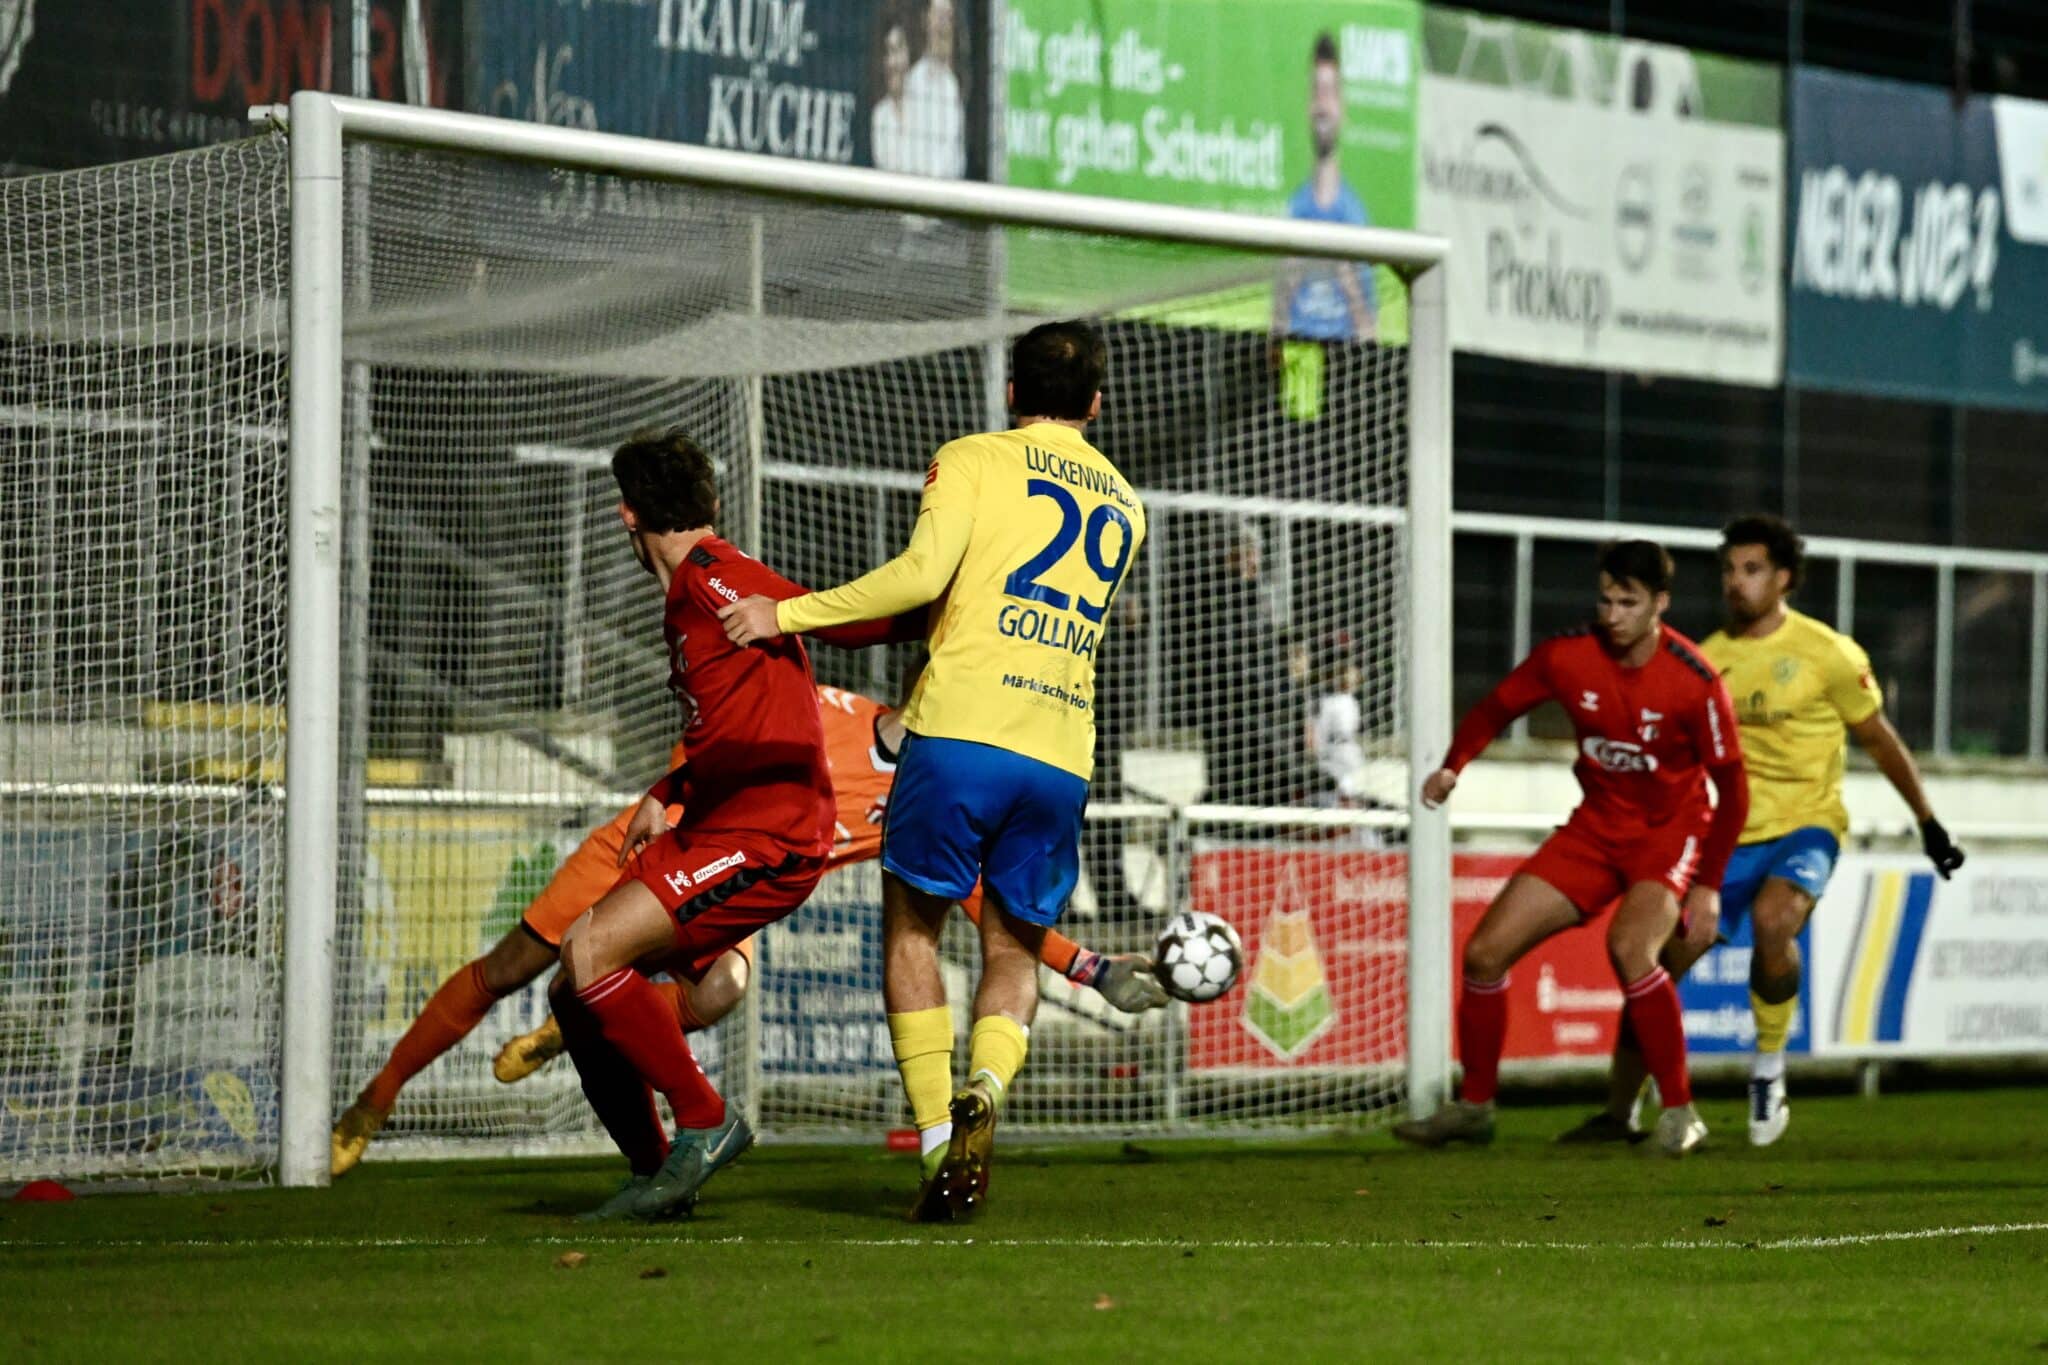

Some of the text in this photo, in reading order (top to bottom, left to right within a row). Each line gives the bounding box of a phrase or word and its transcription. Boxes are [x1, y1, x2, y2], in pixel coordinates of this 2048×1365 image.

[706, 62, 856, 163] KÜCHE
[1025, 445, 1138, 516] LUCKENWAL
[1002, 478, 1134, 625] 29
[707, 576, 740, 603] skatb
[998, 604, 1098, 662] GOLLNA
